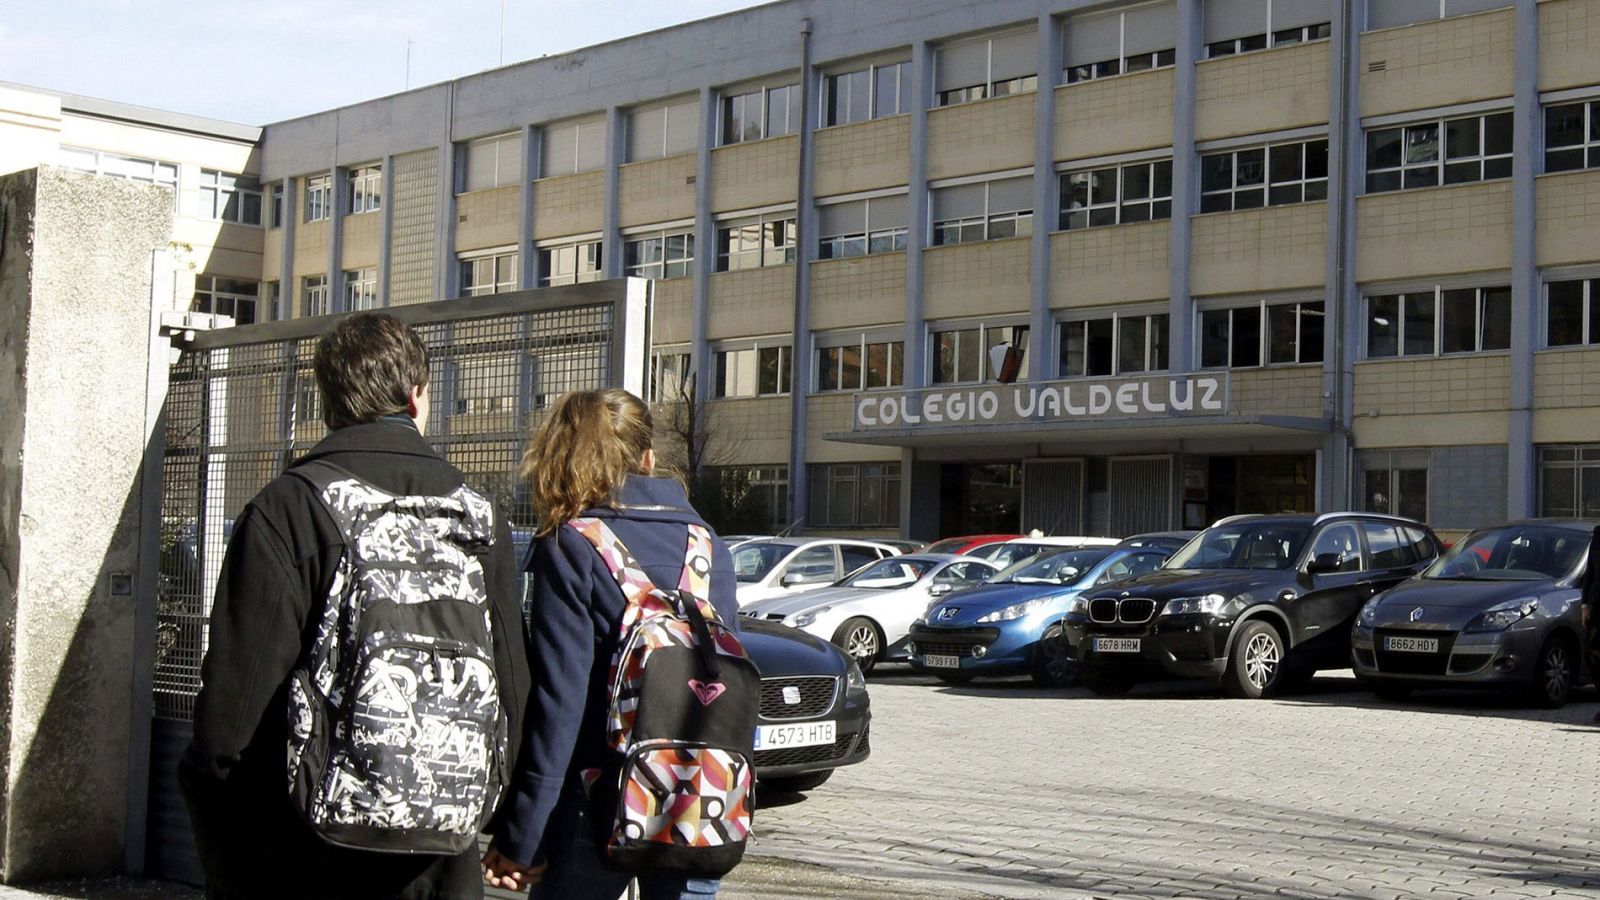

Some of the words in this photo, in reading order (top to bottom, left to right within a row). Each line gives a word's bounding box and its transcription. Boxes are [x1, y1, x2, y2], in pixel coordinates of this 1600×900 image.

[857, 391, 998, 425] COLEGIO
[1098, 640, 1119, 650] 6678
[1121, 640, 1138, 651] HRM
[1390, 638, 1415, 650] 8662
[768, 727, 804, 745] 4573
[809, 724, 833, 742] HTB
